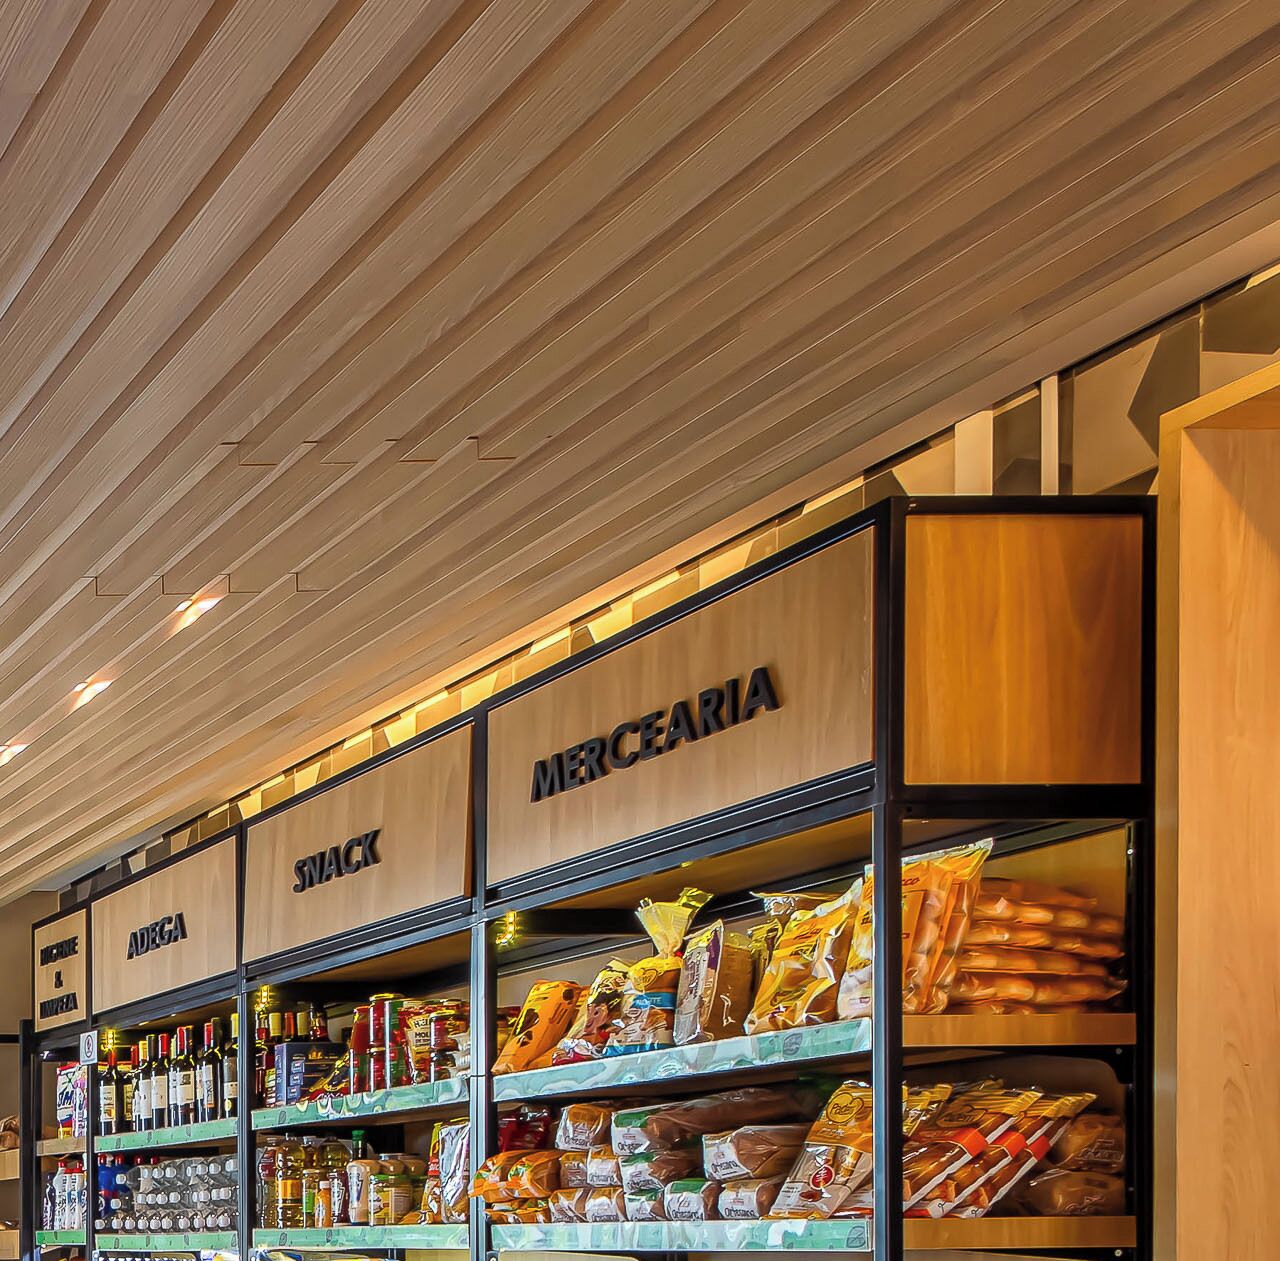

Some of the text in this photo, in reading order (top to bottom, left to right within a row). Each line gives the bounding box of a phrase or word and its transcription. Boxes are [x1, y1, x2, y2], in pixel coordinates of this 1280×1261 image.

[530, 667, 781, 802] MERCEARIA
[292, 828, 381, 894] SNACK
[127, 912, 188, 960] ADEGA
[54, 969, 64, 989] &
